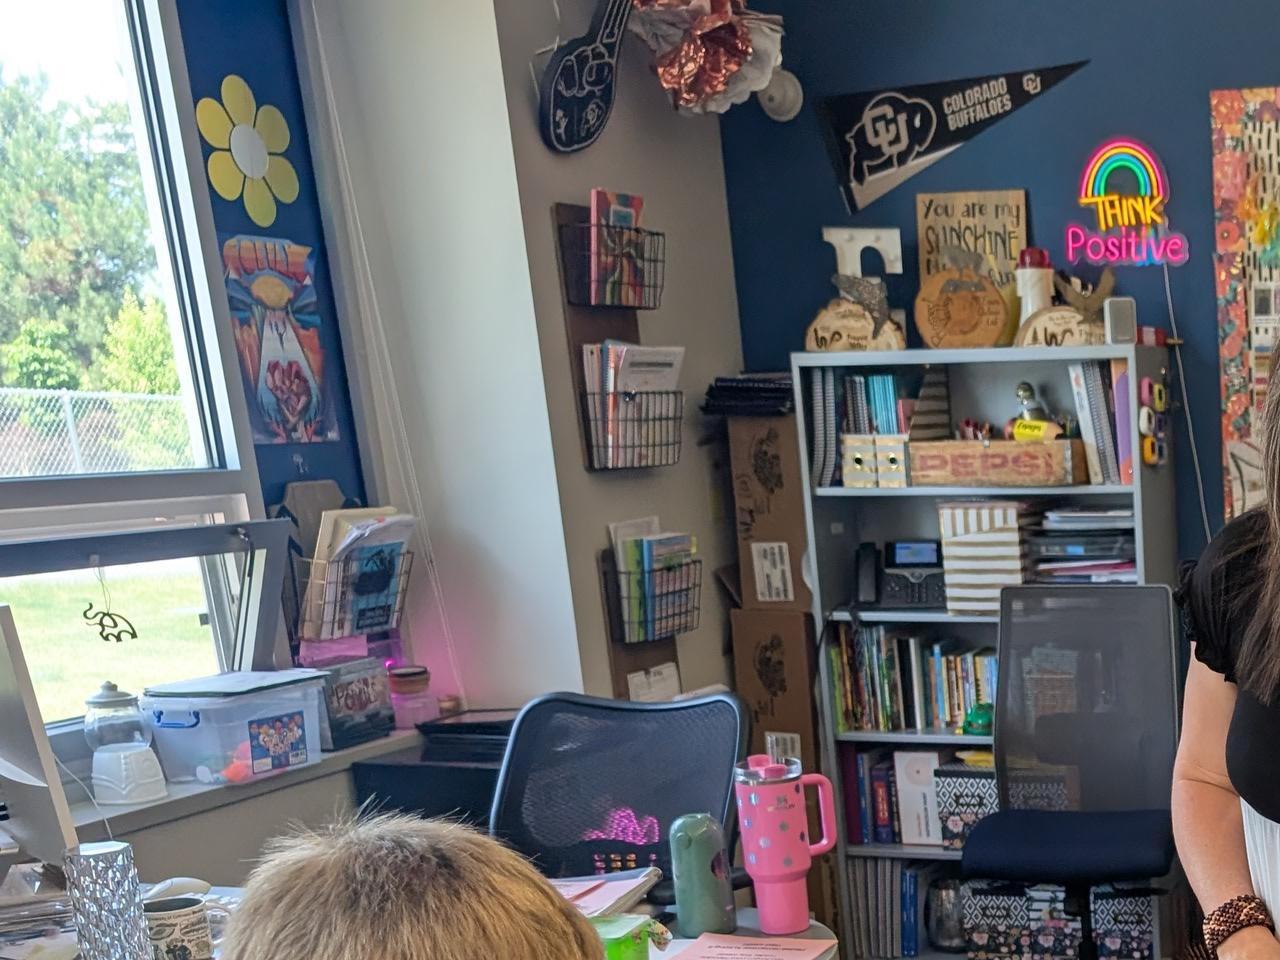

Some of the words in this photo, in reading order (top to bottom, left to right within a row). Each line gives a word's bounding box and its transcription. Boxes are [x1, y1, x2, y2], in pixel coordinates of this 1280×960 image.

[942, 77, 1008, 114] COLORADO
[947, 95, 1012, 131] BUFFALOES
[863, 104, 909, 155] CU
[923, 199, 955, 219] You
[961, 202, 987, 218] are
[994, 203, 1021, 228] my
[1078, 194, 1163, 232] THINK
[1067, 224, 1184, 263] Positive
[919, 452, 1055, 479] PEPSI
